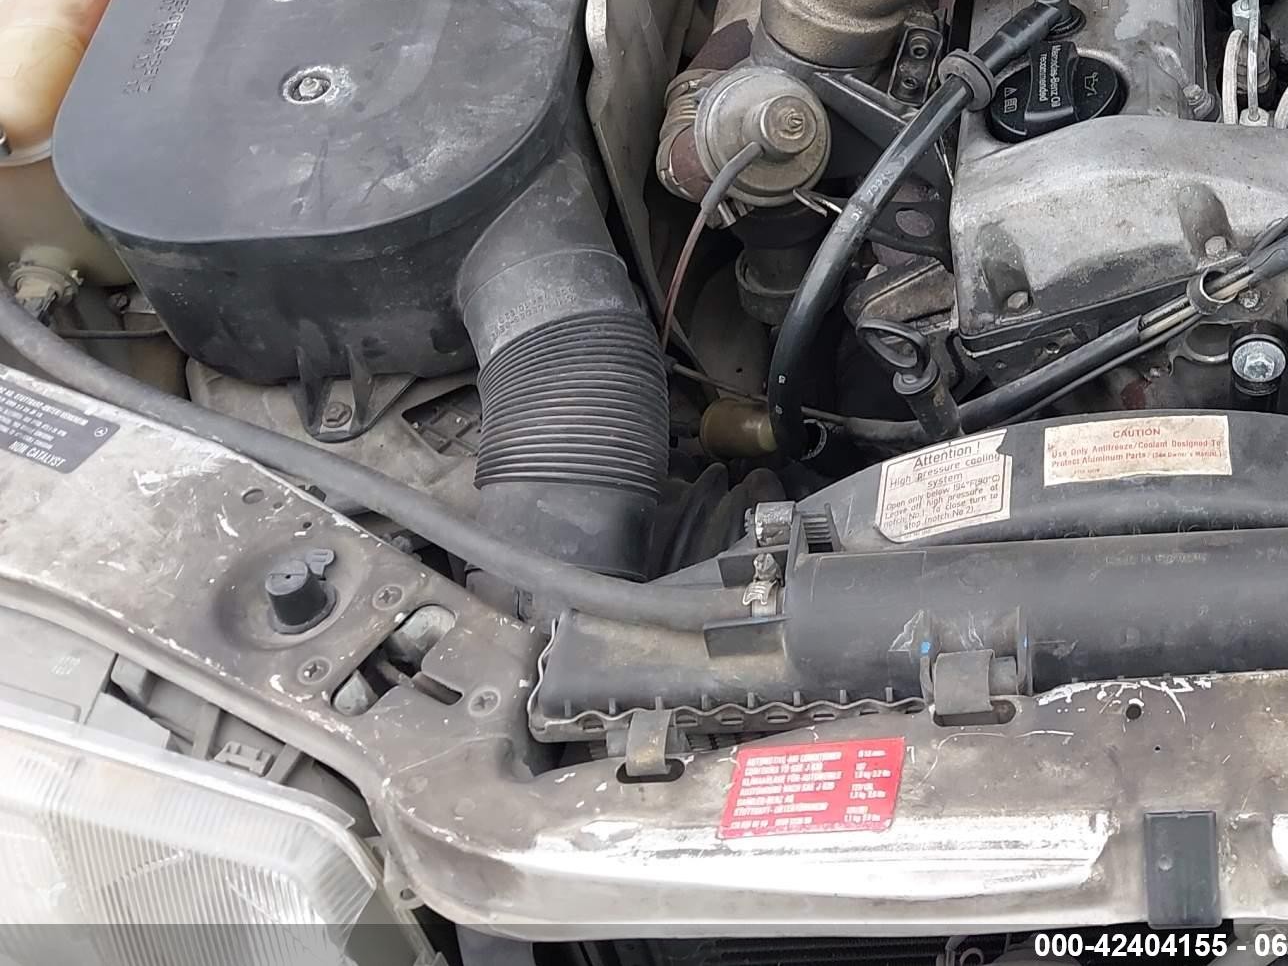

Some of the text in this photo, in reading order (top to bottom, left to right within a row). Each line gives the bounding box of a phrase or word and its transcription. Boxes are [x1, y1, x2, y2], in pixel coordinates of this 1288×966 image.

[1039, 53, 1048, 102] recommended
[1051, 44, 1062, 108] Mercedes-Benz Oil
[1113, 428, 1162, 439] CAUTION
[8, 440, 67, 468] NON CATALYST
[913, 444, 972, 469] Attention
[1051, 449, 1068, 459] Use
[1070, 446, 1089, 459] Only
[1092, 440, 1168, 454] Antifreeze/Coolant
[1171, 439, 1208, 449] Designed
[1051, 458, 1080, 468] Protect
[1081, 453, 1124, 465] Aluminum
[889, 452, 1001, 489] High pressure cooling
[927, 472, 963, 489] system
[885, 483, 999, 520] Leave off high pressure at
[886, 499, 907, 513] Open
[907, 493, 923, 506] only
[926, 487, 950, 500] below
[932, 505, 941, 514] To
[945, 499, 966, 511] close
[969, 494, 986, 505] turn
[990, 492, 999, 501] to
[903, 518, 921, 531] stop
[924, 509, 951, 526] (notch
